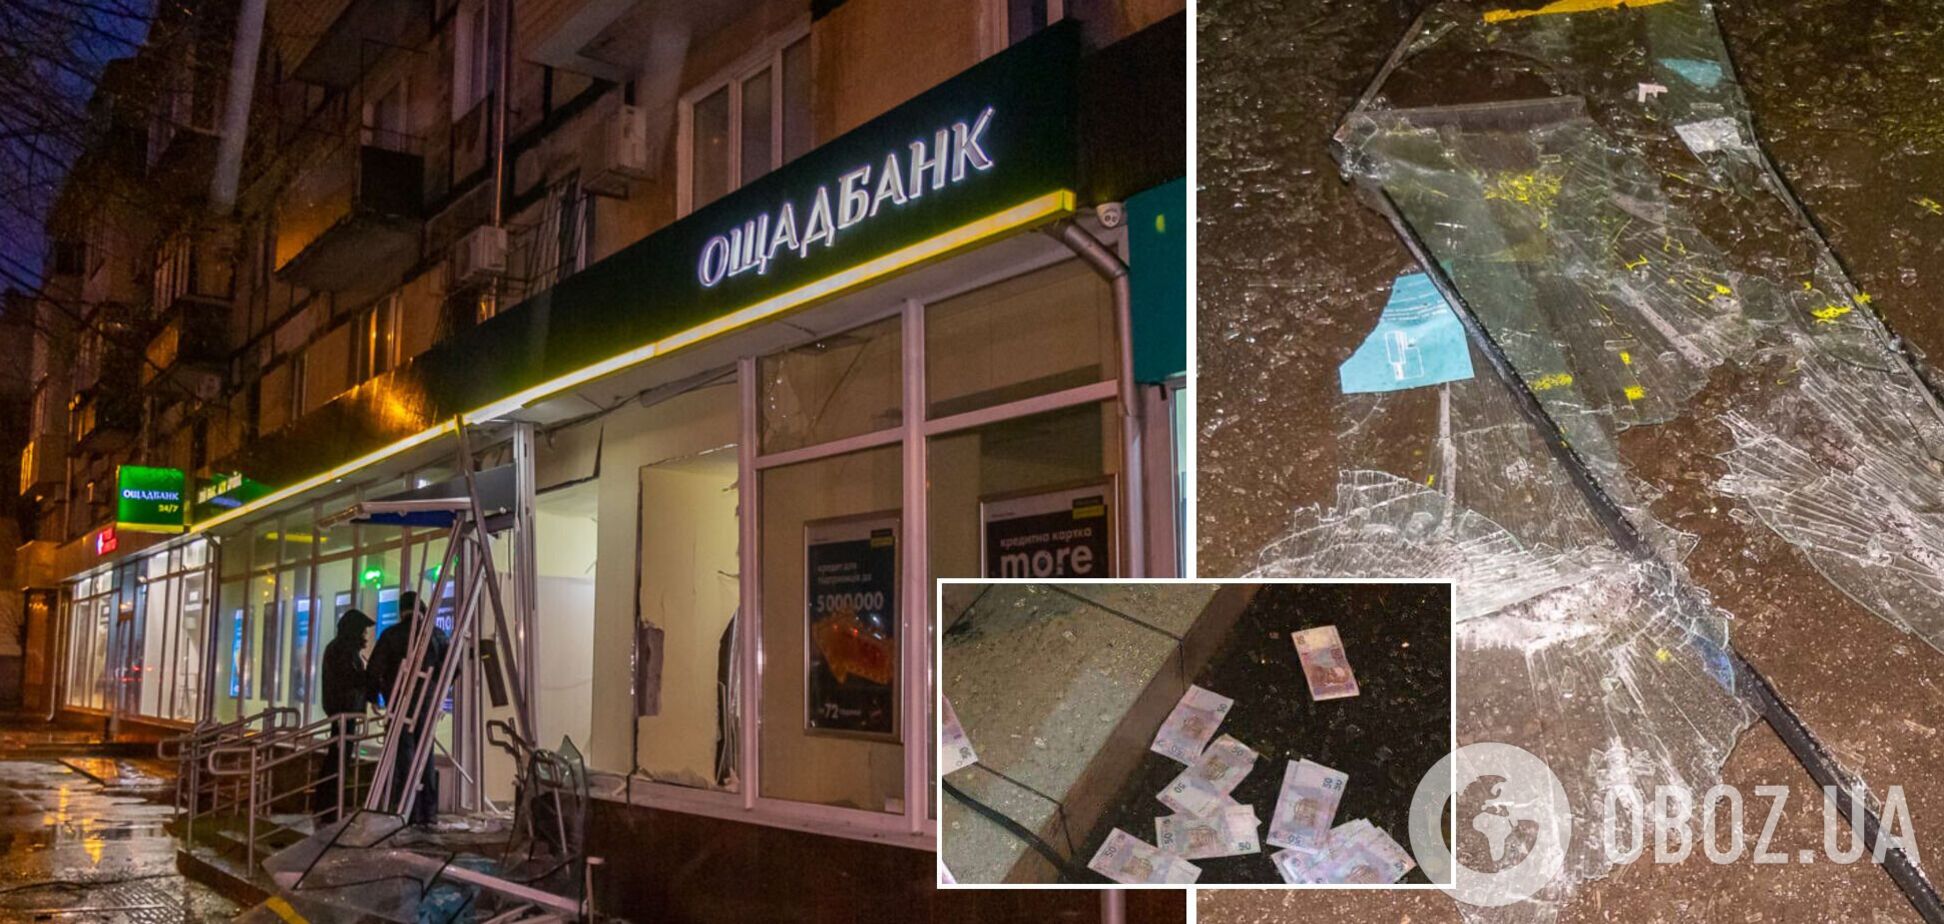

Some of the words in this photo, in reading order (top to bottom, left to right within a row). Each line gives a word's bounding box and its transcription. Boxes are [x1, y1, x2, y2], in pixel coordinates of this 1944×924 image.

[698, 106, 995, 287] ОЩАДБАНК
[122, 489, 180, 501] ОЩАДБАНК
[158, 504, 179, 513] 24/7
[1000, 545, 1093, 578] more
